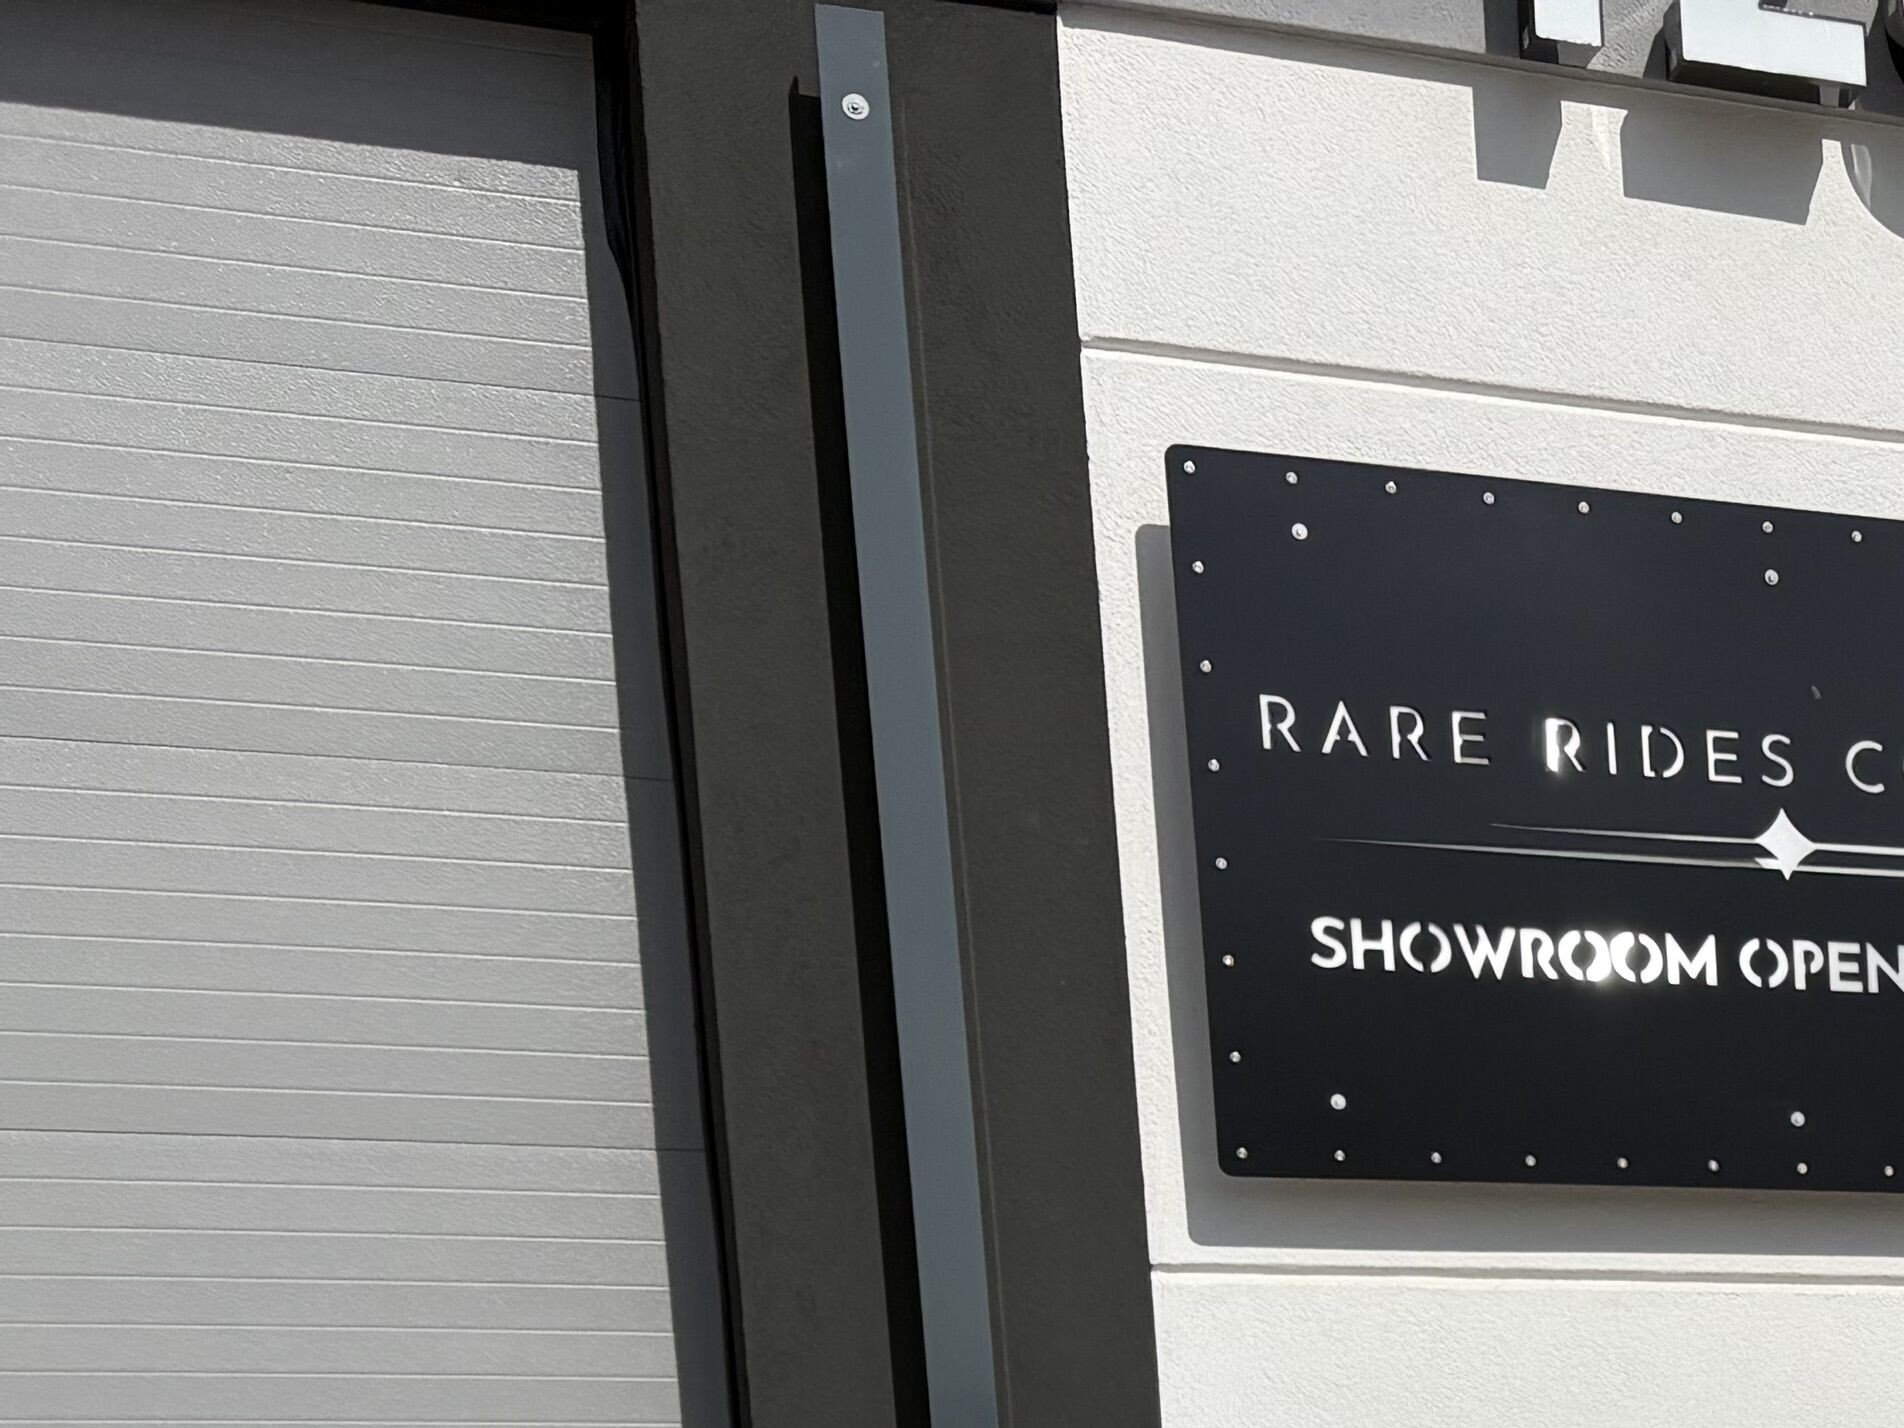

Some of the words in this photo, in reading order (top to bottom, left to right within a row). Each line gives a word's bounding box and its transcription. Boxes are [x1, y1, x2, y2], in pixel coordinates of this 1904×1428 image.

[1258, 693, 1490, 766] RARE
[1544, 716, 1795, 788] RIDES
[1309, 915, 1718, 987] SHOWROOM
